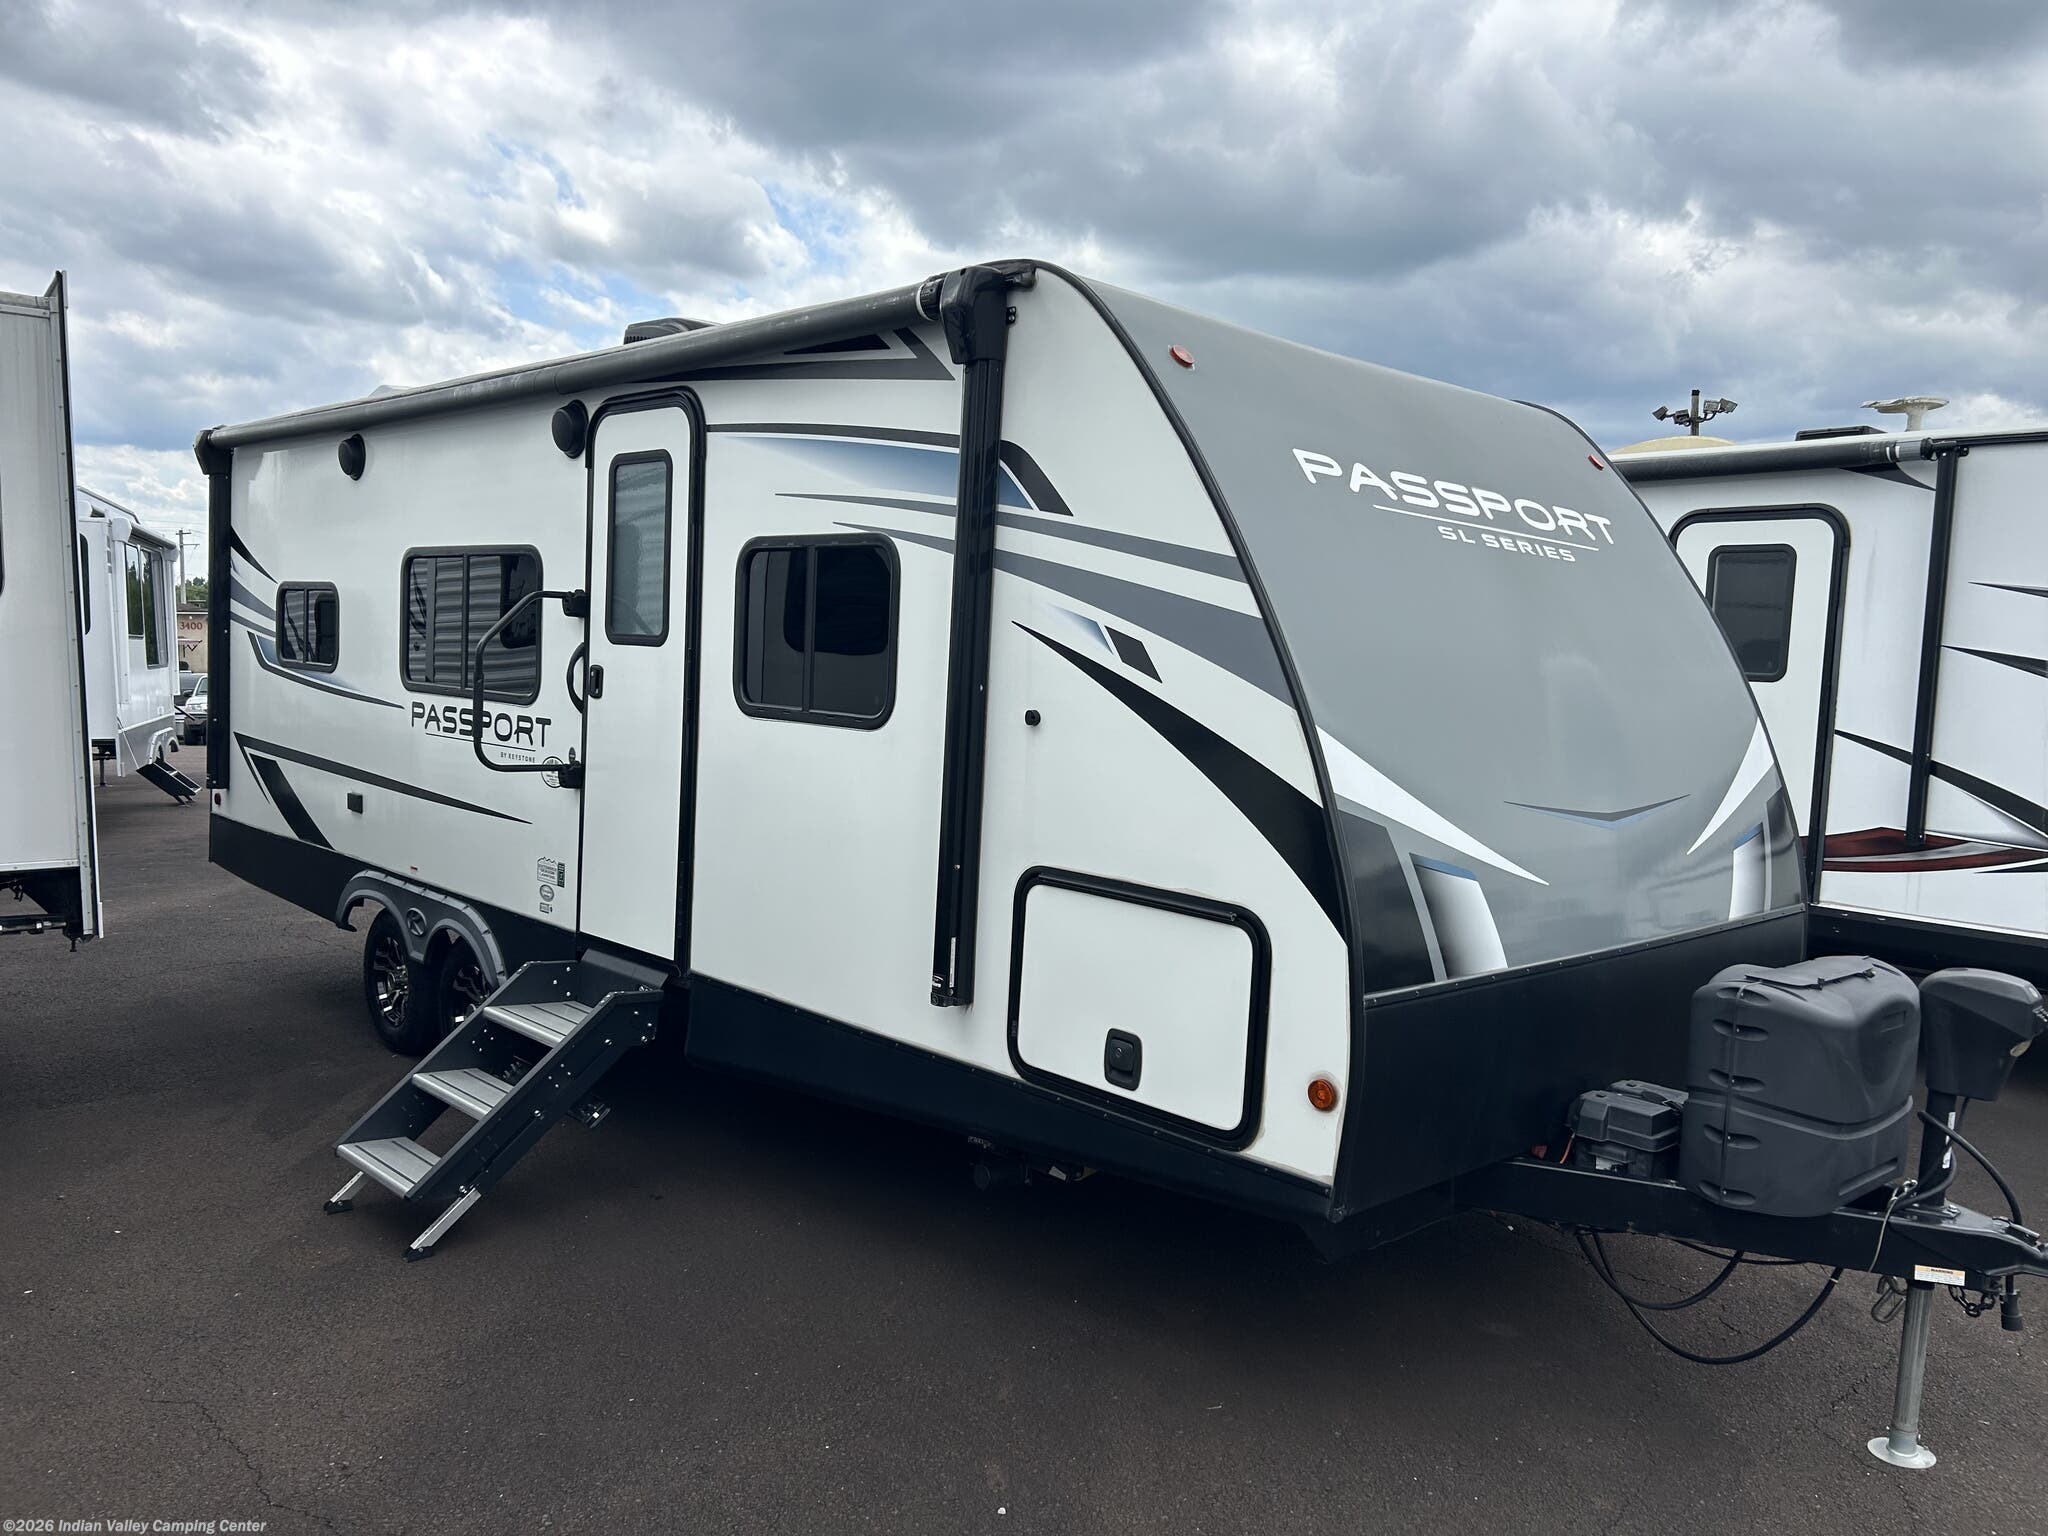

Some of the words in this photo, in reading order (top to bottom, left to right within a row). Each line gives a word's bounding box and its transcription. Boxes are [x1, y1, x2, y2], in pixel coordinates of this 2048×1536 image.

[1292, 448, 1614, 545] PASSPORT
[1437, 525, 1476, 545] SL
[1481, 533, 1576, 562] SERIES
[179, 621, 203, 630] 3400
[508, 753, 536, 763] KEYSTONE
